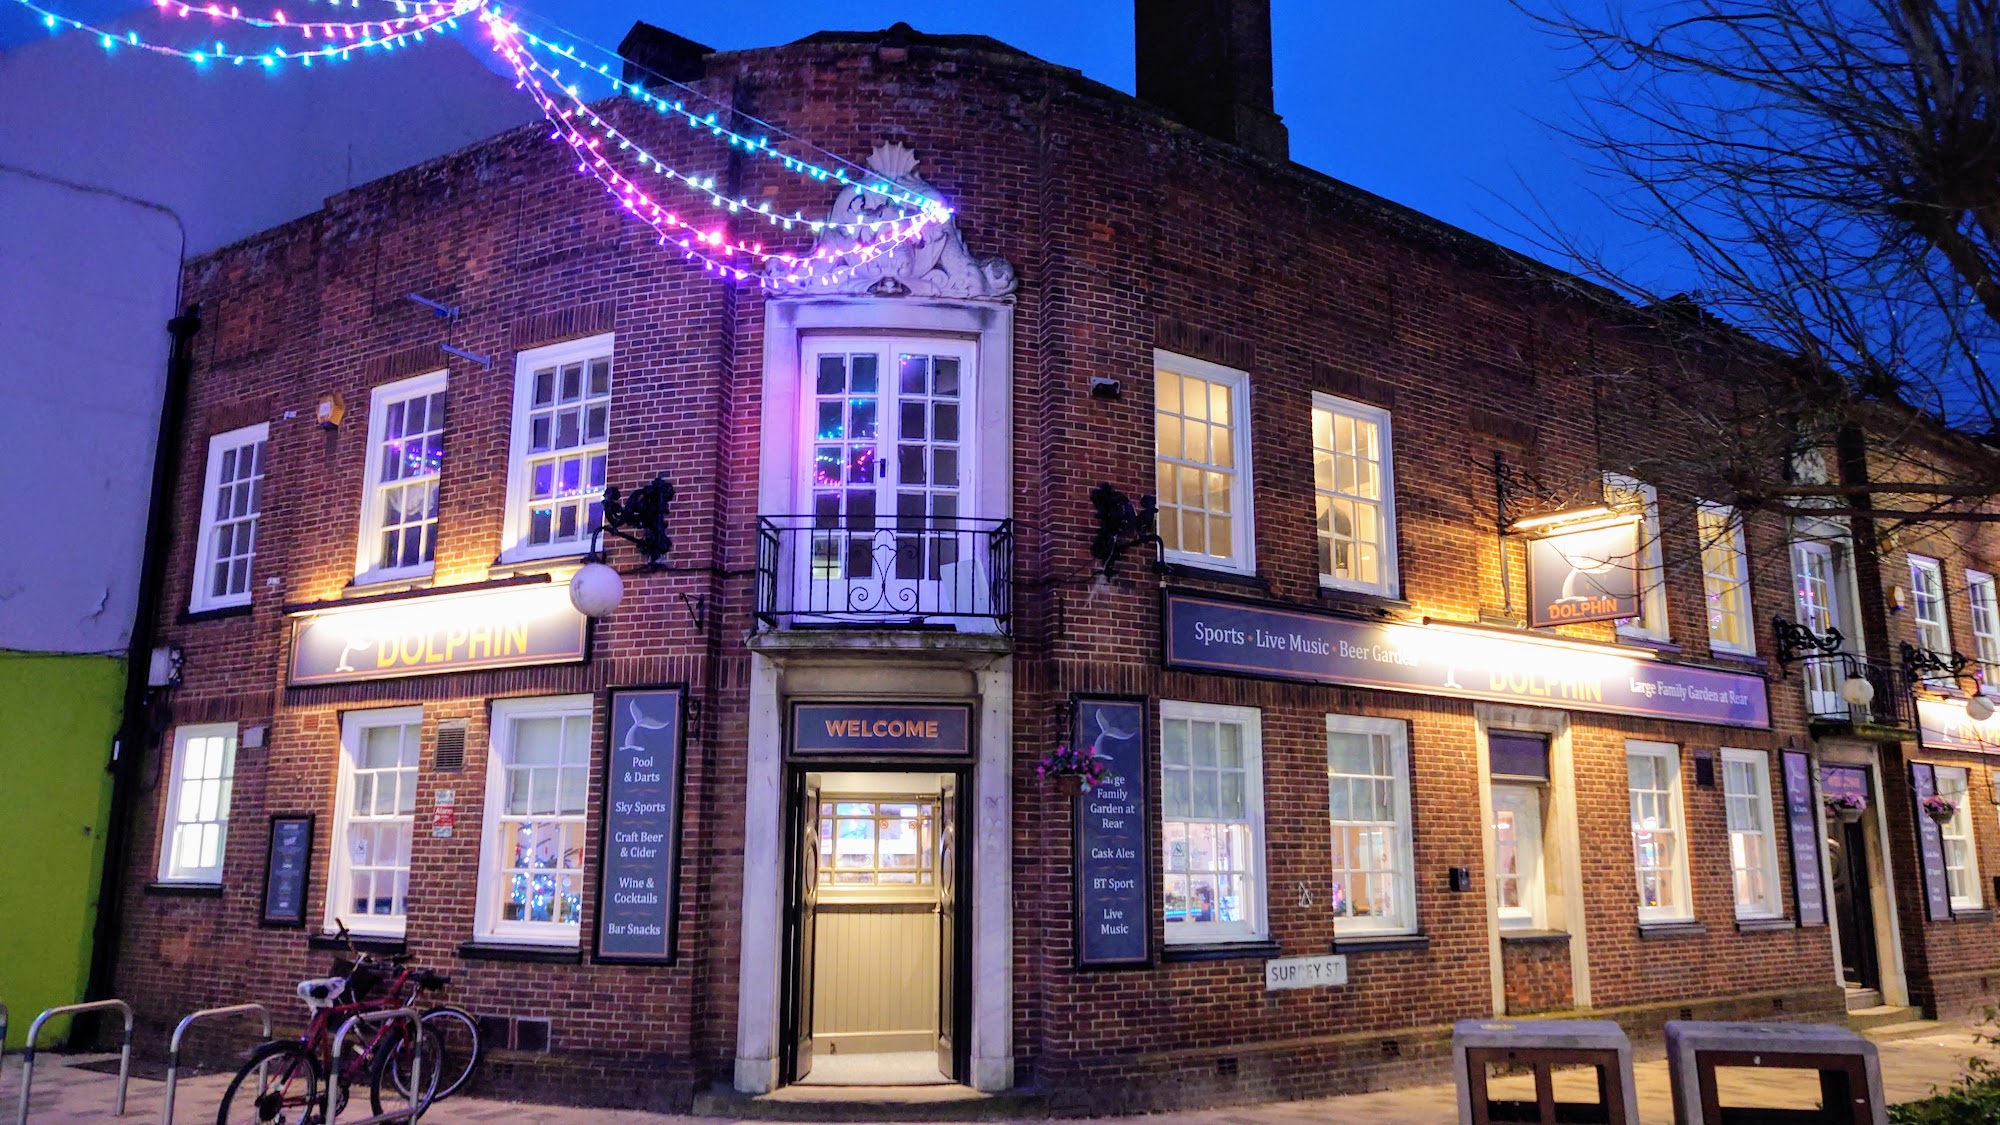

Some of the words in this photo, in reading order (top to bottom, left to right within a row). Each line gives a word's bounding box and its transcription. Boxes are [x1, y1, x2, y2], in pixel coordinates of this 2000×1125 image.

[1547, 598, 1618, 619] DOLPHIN
[377, 620, 529, 668] DOLPHIN
[1194, 621, 1245, 646] Sports
[1255, 629, 1286, 650] Live
[1289, 633, 1330, 656] Music
[1339, 640, 1370, 660] Beer
[1488, 669, 1602, 702] DOLPHIN
[1629, 677, 1656, 698] Large
[1657, 681, 1686, 701] Family
[1688, 685, 1719, 703] Garden
[1719, 691, 1728, 703] at
[1729, 690, 1749, 706] Rear
[825, 719, 939, 738] WELCOME
[632, 756, 654, 768] Pool
[624, 771, 632, 782] &
[634, 772, 661, 783] Darts
[1102, 774, 1126, 786] age
[1097, 788, 1128, 802] Family
[615, 802, 632, 815] Sky
[634, 802, 666, 815] Sports
[1090, 803, 1124, 814] Garden
[1125, 804, 1136, 814] at
[1102, 818, 1124, 829] Rear
[615, 831, 639, 843] Craft
[640, 832, 664, 843] Beer
[620, 847, 628, 858] &
[630, 846, 657, 858] Cider
[1091, 848, 1114, 859] Cask
[1115, 848, 1135, 859] Ales
[619, 877, 645, 889] Wine
[646, 877, 655, 889] &
[1093, 878, 1107, 889] BT
[1108, 878, 1135, 891] Sport
[614, 892, 658, 904] Cocktails
[1103, 908, 1123, 919] Live
[608, 923, 626, 934] Bar
[627, 923, 661, 935] Snacks
[1101, 924, 1129, 935] Music
[1326, 962, 1340, 977] ST
